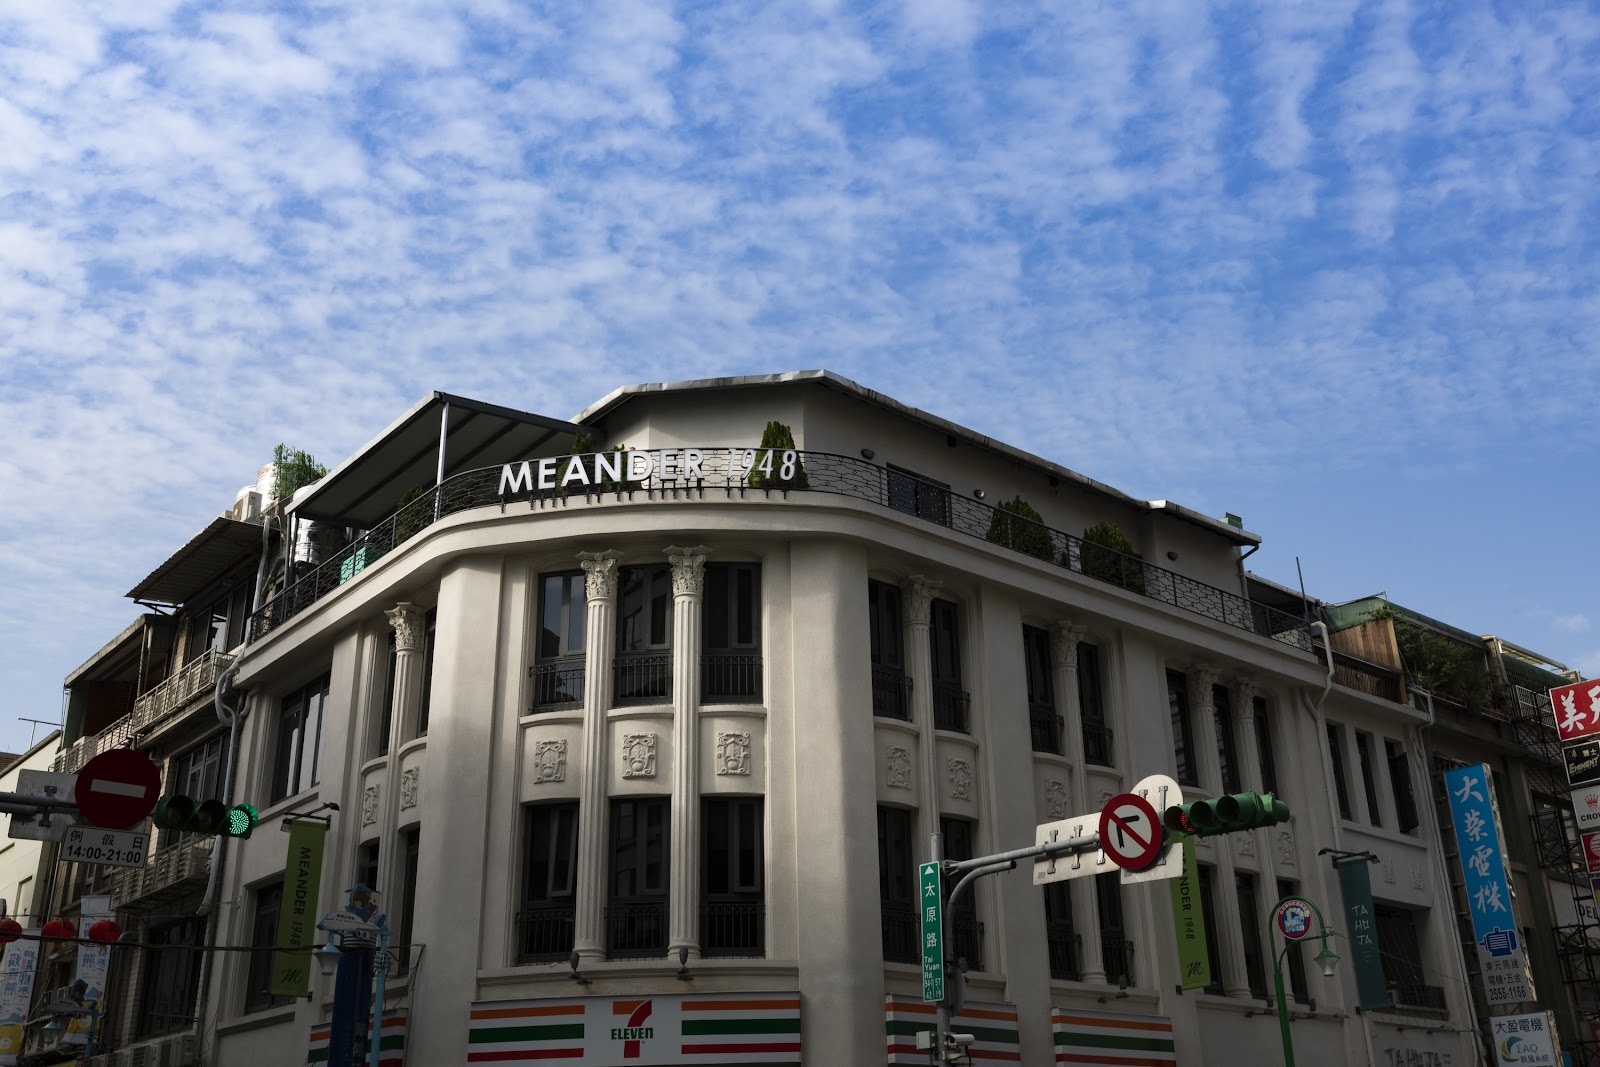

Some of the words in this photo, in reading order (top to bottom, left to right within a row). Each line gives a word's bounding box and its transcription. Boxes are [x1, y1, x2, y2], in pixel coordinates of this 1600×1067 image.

[498, 448, 704, 495] MEANDER
[726, 448, 797, 481] 1948
[1569, 757, 1599, 774] EMINENT
[70, 830, 143, 849] 例假日
[67, 844, 141, 863] 14:00-21:00
[293, 846, 312, 915] MEANDER
[924, 882, 938, 949] 太原路
[290, 922, 303, 946] 1948
[1184, 917, 1195, 939] 1948
[924, 955, 934, 964] Tai
[924, 963, 940, 971] Yuan
[1485, 958, 1519, 972] 東元馬達
[1488, 985, 1526, 1001] 2555-1166
[1495, 1017, 1543, 1034] 大盈電機
[1516, 1043, 1538, 1054] IAQ
